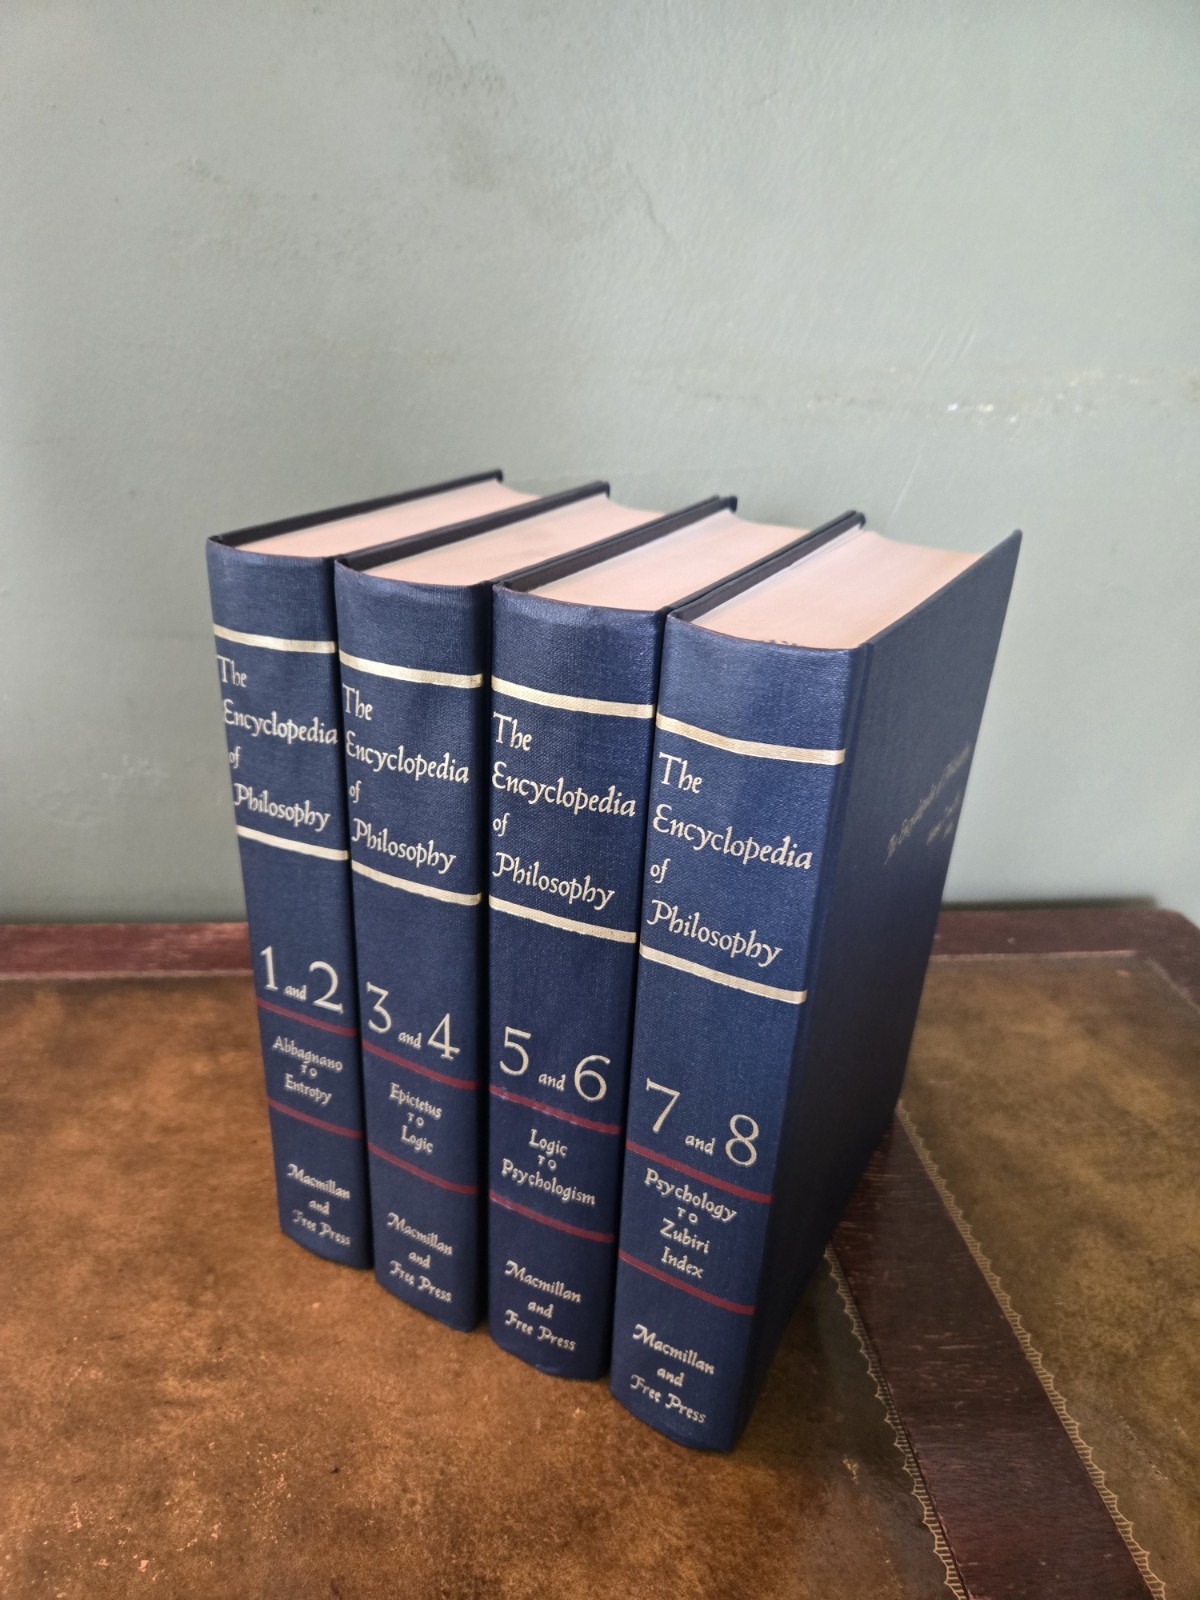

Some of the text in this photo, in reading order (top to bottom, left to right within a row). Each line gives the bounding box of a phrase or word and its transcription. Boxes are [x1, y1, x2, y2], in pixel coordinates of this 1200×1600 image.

[217, 655, 248, 688] The
[342, 683, 373, 720] The
[224, 698, 338, 744] Encyclopedia
[493, 712, 532, 751] The
[229, 746, 241, 769] of
[346, 730, 469, 784] Encyclopedia
[658, 752, 702, 794] The
[234, 783, 330, 832] Philosophy
[349, 780, 362, 803] of
[492, 761, 636, 817] Encyclopedia
[493, 813, 510, 836] of
[653, 803, 813, 870] Encyclopedia
[351, 818, 456, 874] Philosophy
[492, 852, 615, 911] Philosophy
[650, 859, 671, 884] of
[646, 899, 783, 967] Philosophy
[259, 945, 343, 1015] 1 and 2
[366, 981, 461, 1061] 3 and 4
[272, 1035, 343, 1073] Abbagnano
[301, 1064, 317, 1078] TO
[499, 1026, 611, 1102] 5 and 6
[284, 1073, 333, 1106] Entropy
[388, 1082, 443, 1120] Epictetus
[401, 1124, 434, 1155] Logic
[407, 1113, 425, 1128] TO
[645, 1078, 760, 1167] 7 and 8
[528, 1128, 567, 1158] Logic
[287, 1163, 351, 1200] Macmillan
[501, 1157, 596, 1207] Psychologism
[538, 1158, 557, 1171] TO
[308, 1197, 330, 1216] and
[644, 1167, 738, 1225] Psychology
[676, 1206, 699, 1224] TO
[292, 1209, 351, 1247] Free Press
[386, 1211, 453, 1257] Macmillan
[659, 1218, 711, 1255] Zubiri
[408, 1249, 431, 1270] and
[660, 1246, 704, 1280] Index
[389, 1260, 452, 1303] Free Press
[505, 1259, 582, 1305] Macmillan
[527, 1299, 553, 1320] and
[505, 1309, 577, 1352] Free Press
[632, 1323, 715, 1375] Macmillan
[656, 1365, 685, 1388] and
[630, 1373, 707, 1426] Free Press
